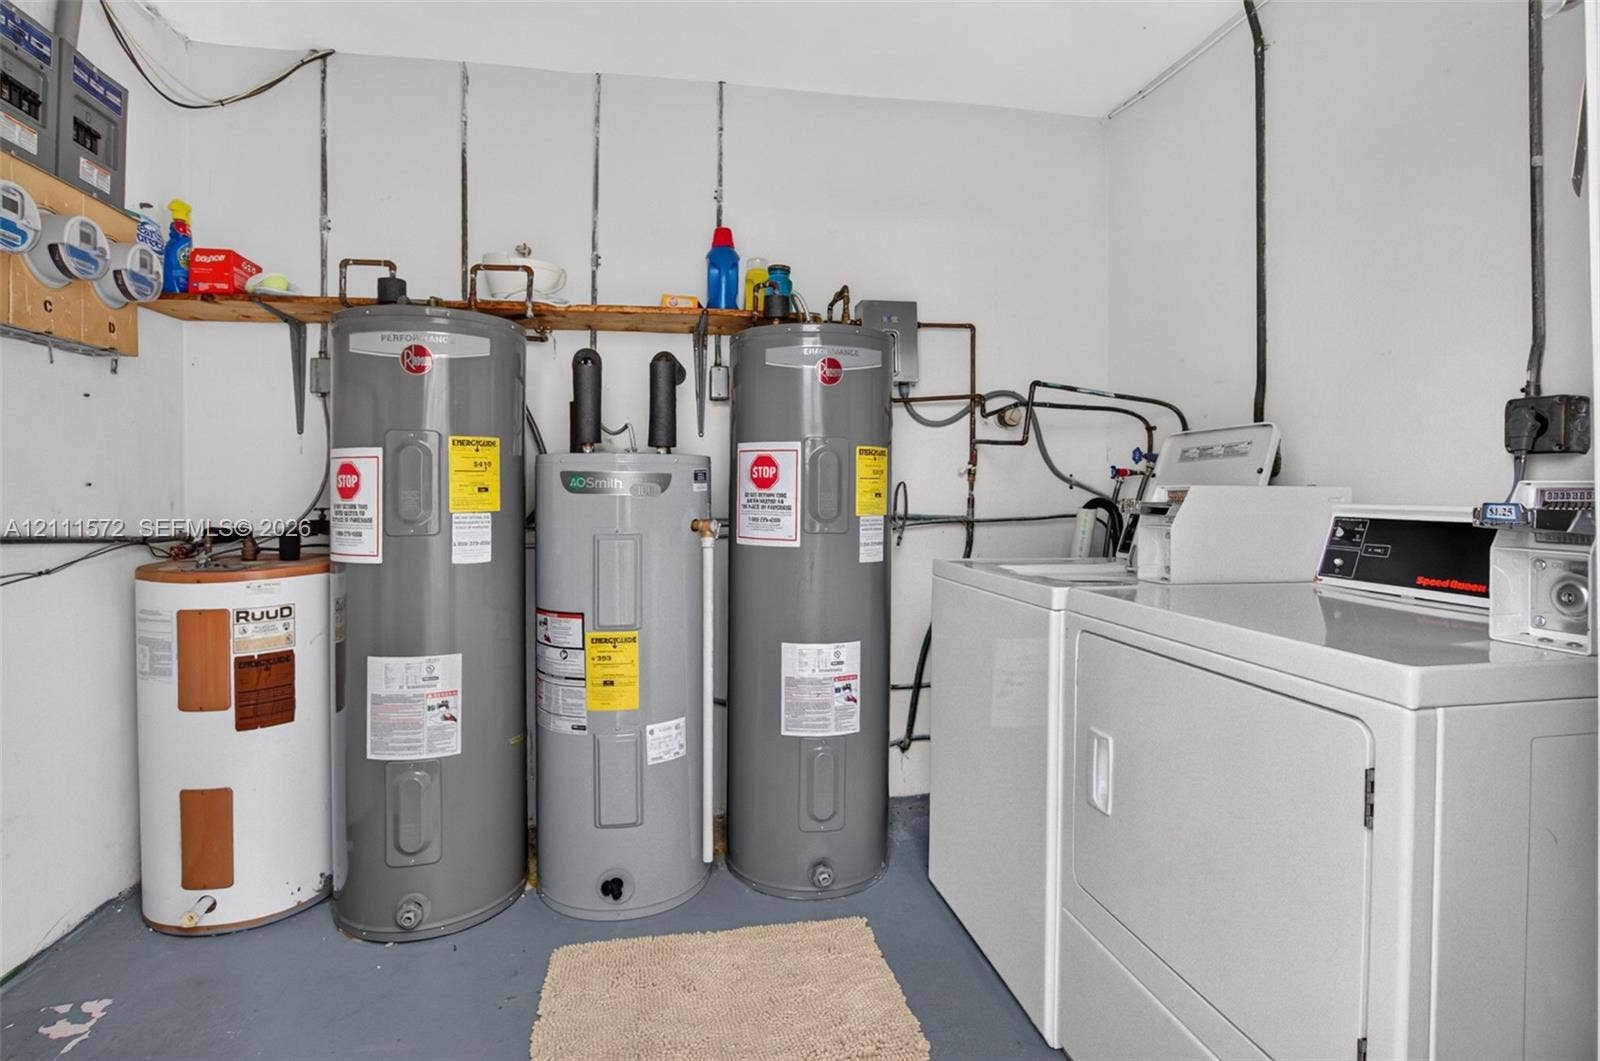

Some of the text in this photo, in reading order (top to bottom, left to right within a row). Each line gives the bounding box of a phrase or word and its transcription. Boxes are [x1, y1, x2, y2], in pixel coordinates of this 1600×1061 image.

[43, 300, 53, 313] C
[108, 321, 116, 333] D
[752, 466, 776, 479] STOP
[337, 474, 358, 489] STOP
[1415, 575, 1488, 593] Speed Queen
[236, 606, 293, 623] RUUD
